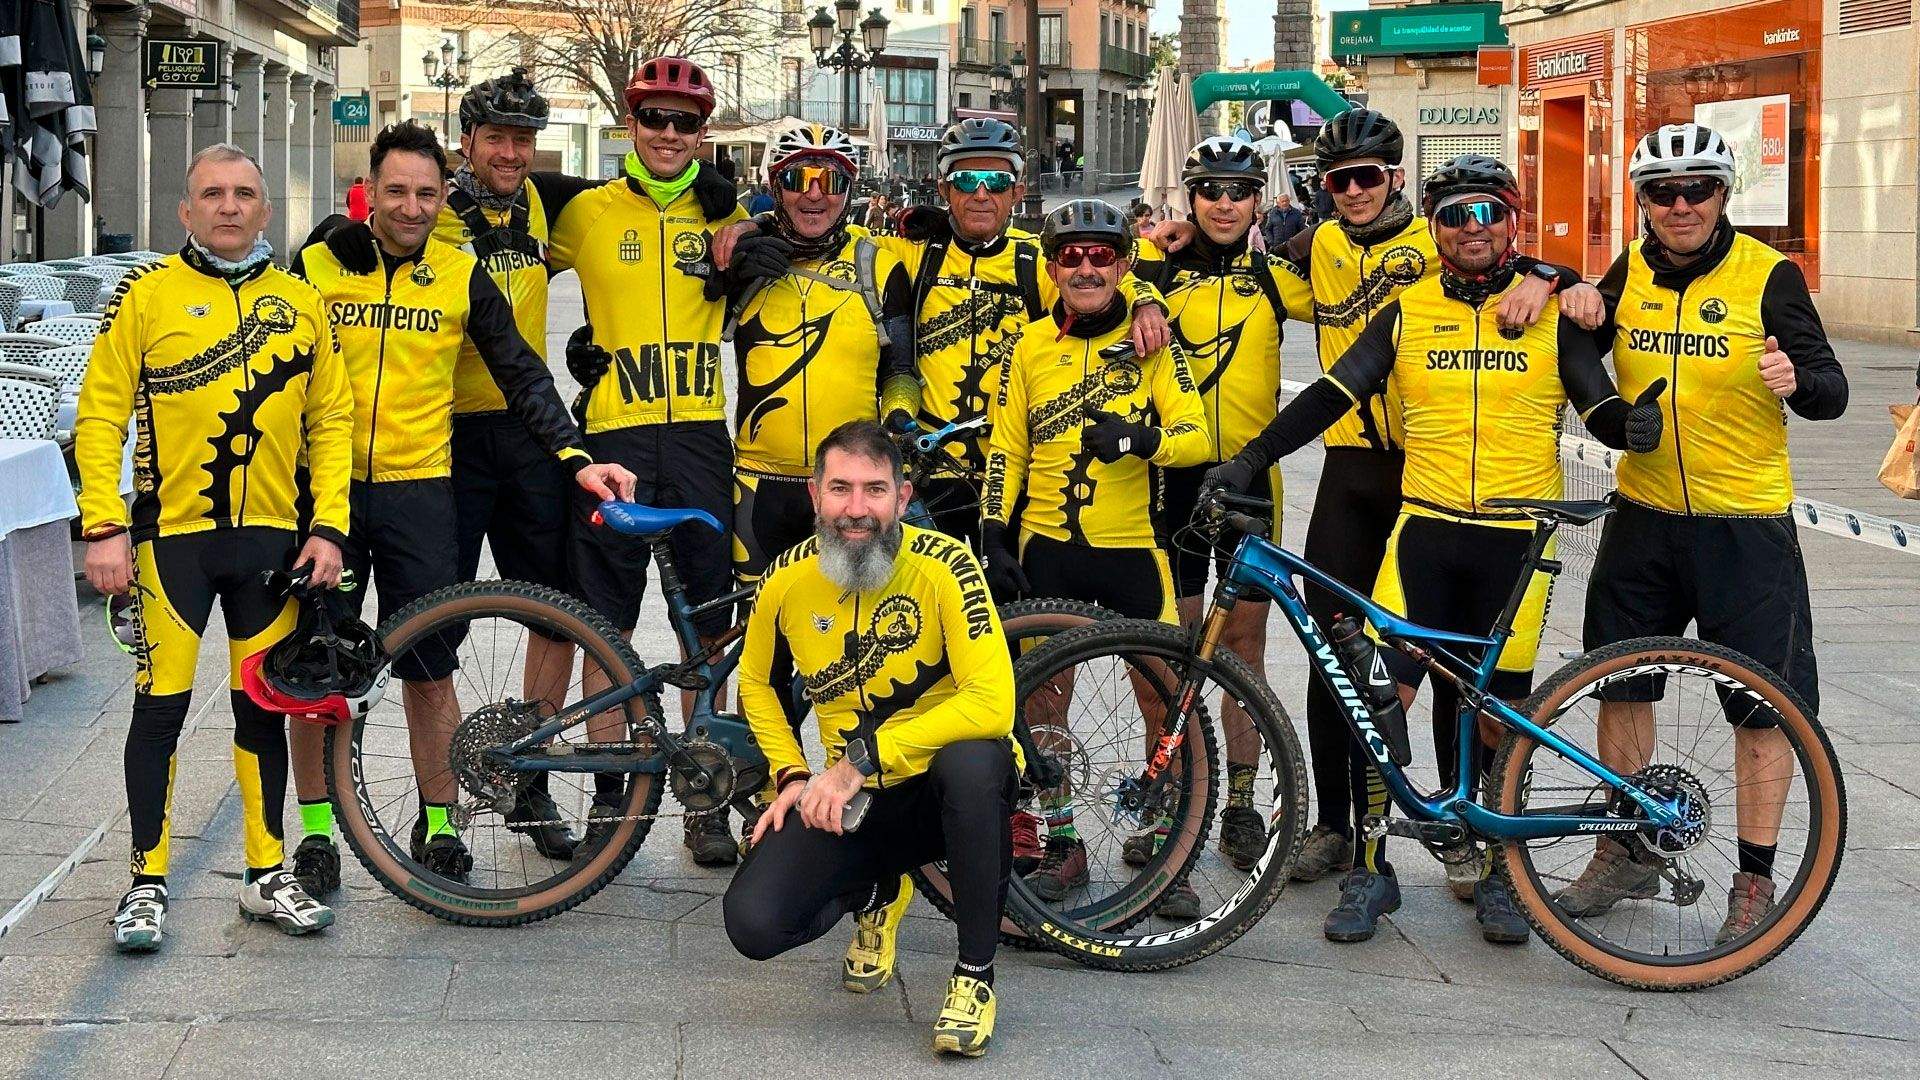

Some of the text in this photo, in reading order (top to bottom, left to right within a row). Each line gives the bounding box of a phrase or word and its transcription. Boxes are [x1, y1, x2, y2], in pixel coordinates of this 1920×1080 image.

[1340, 36, 1374, 45] OREJANA
[1536, 50, 1588, 79] bankinter.
[162, 73, 200, 81] GOYO
[1419, 106, 1499, 125] DOUGLAS
[910, 533, 993, 641] SEXMEROS
[1634, 654, 1723, 670] MAXXIS
[1294, 613, 1390, 763] S-WORKS
[1630, 790, 1673, 819] EPIC
[1577, 822, 1638, 831] SPECIALIZED
[1040, 921, 1123, 958] MAXXIS
